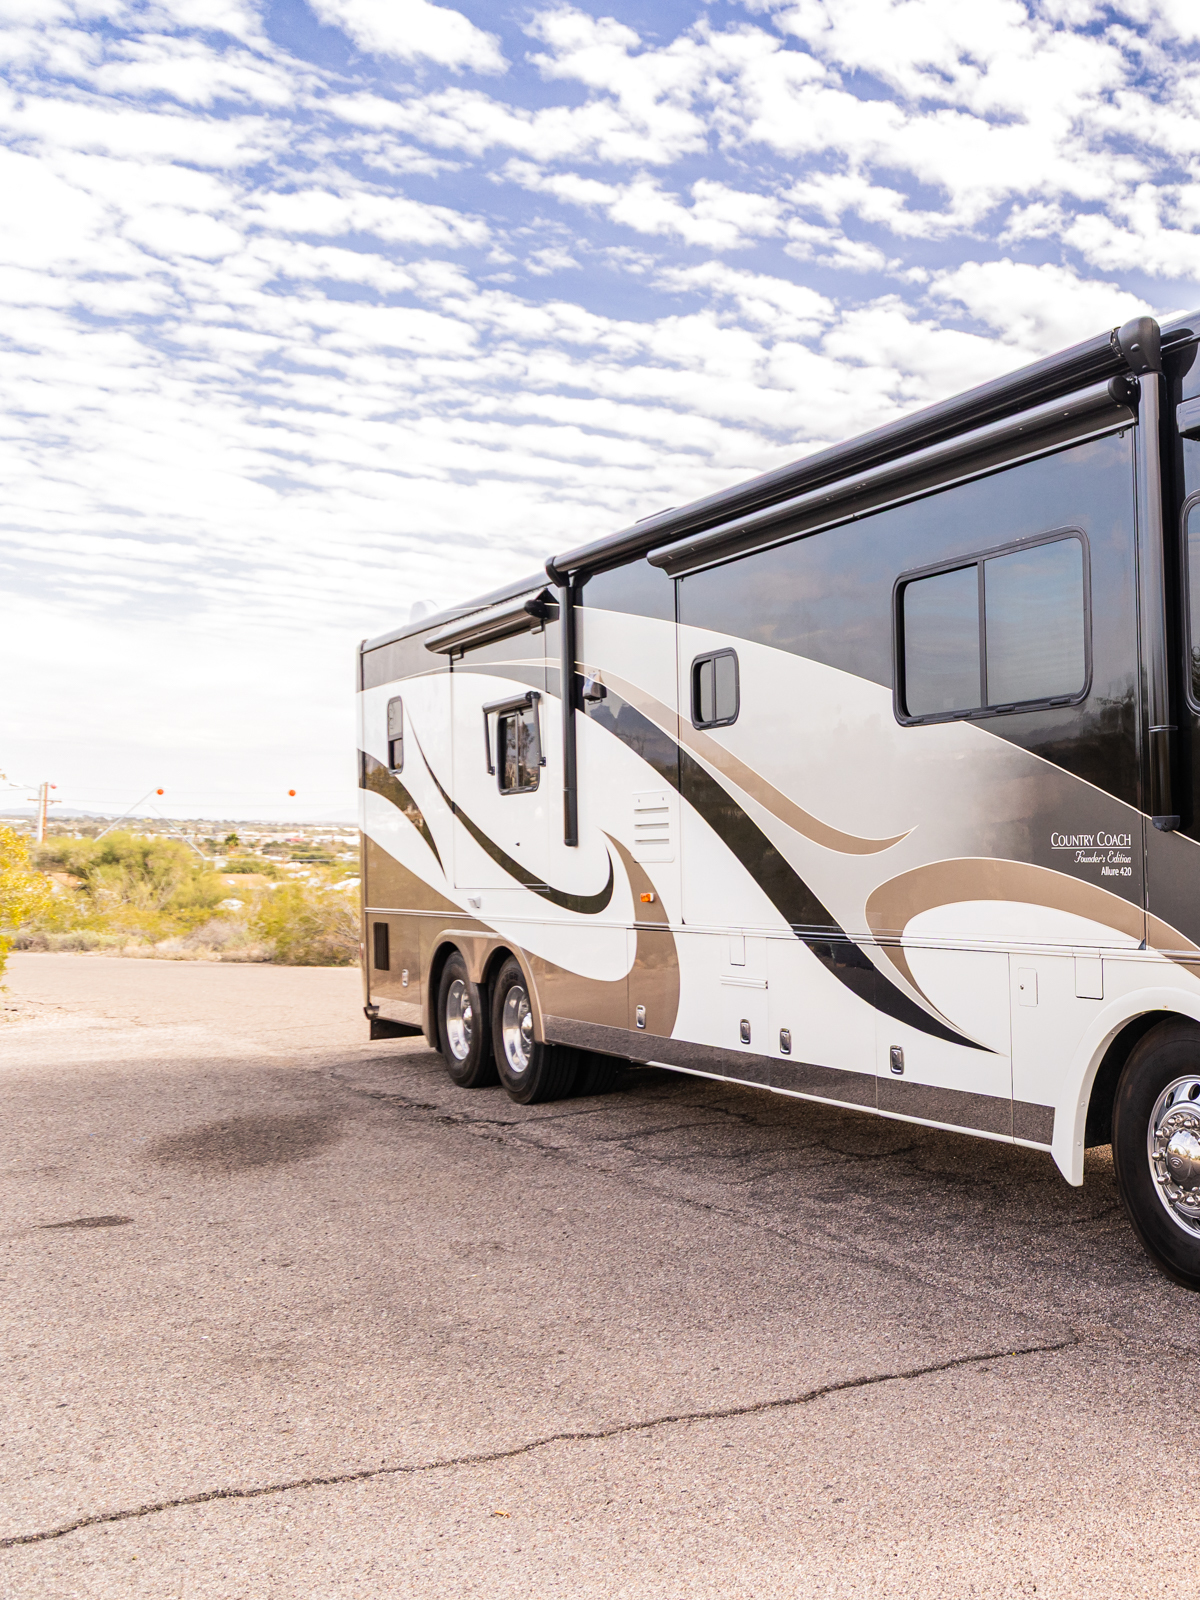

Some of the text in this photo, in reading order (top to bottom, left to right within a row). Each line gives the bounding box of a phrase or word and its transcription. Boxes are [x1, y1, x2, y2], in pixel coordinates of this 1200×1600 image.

[1050, 831, 1132, 847] COUNTRY COACH
[1074, 850, 1132, 863] Founder's Edition
[1101, 866, 1132, 876] Allure 420
